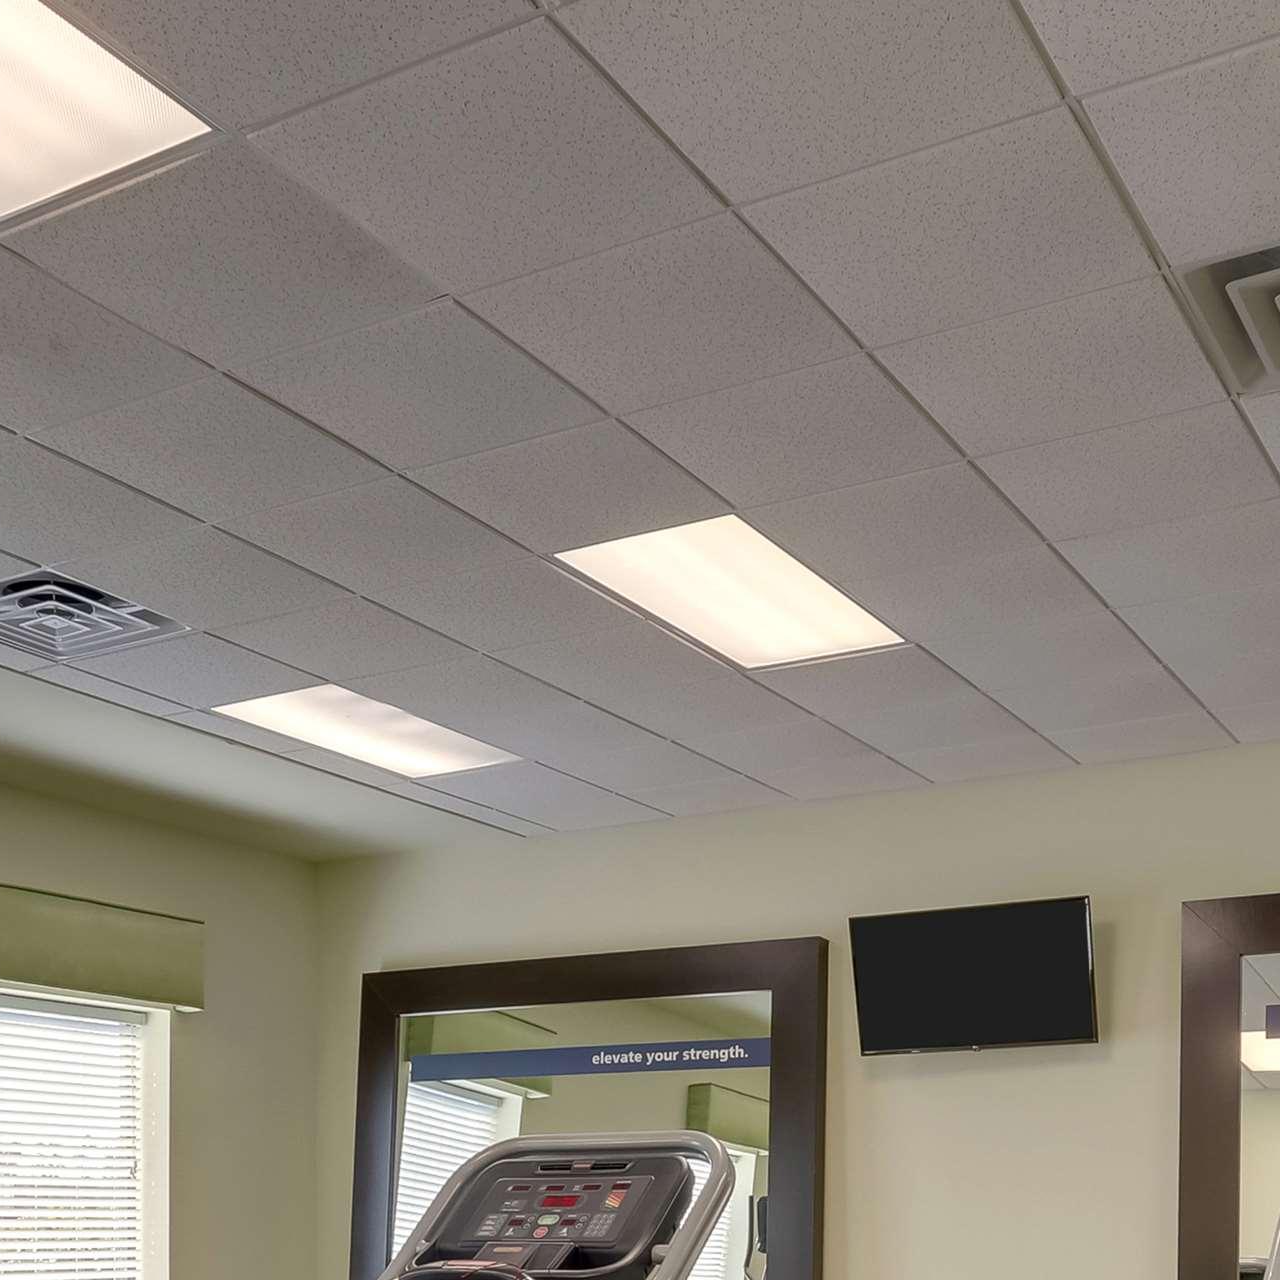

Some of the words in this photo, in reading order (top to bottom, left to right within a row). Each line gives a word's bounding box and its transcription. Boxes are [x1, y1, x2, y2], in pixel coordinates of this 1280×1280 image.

[591, 1051, 643, 1065] elevate
[646, 1050, 679, 1065] your
[682, 1045, 749, 1062] strength.
